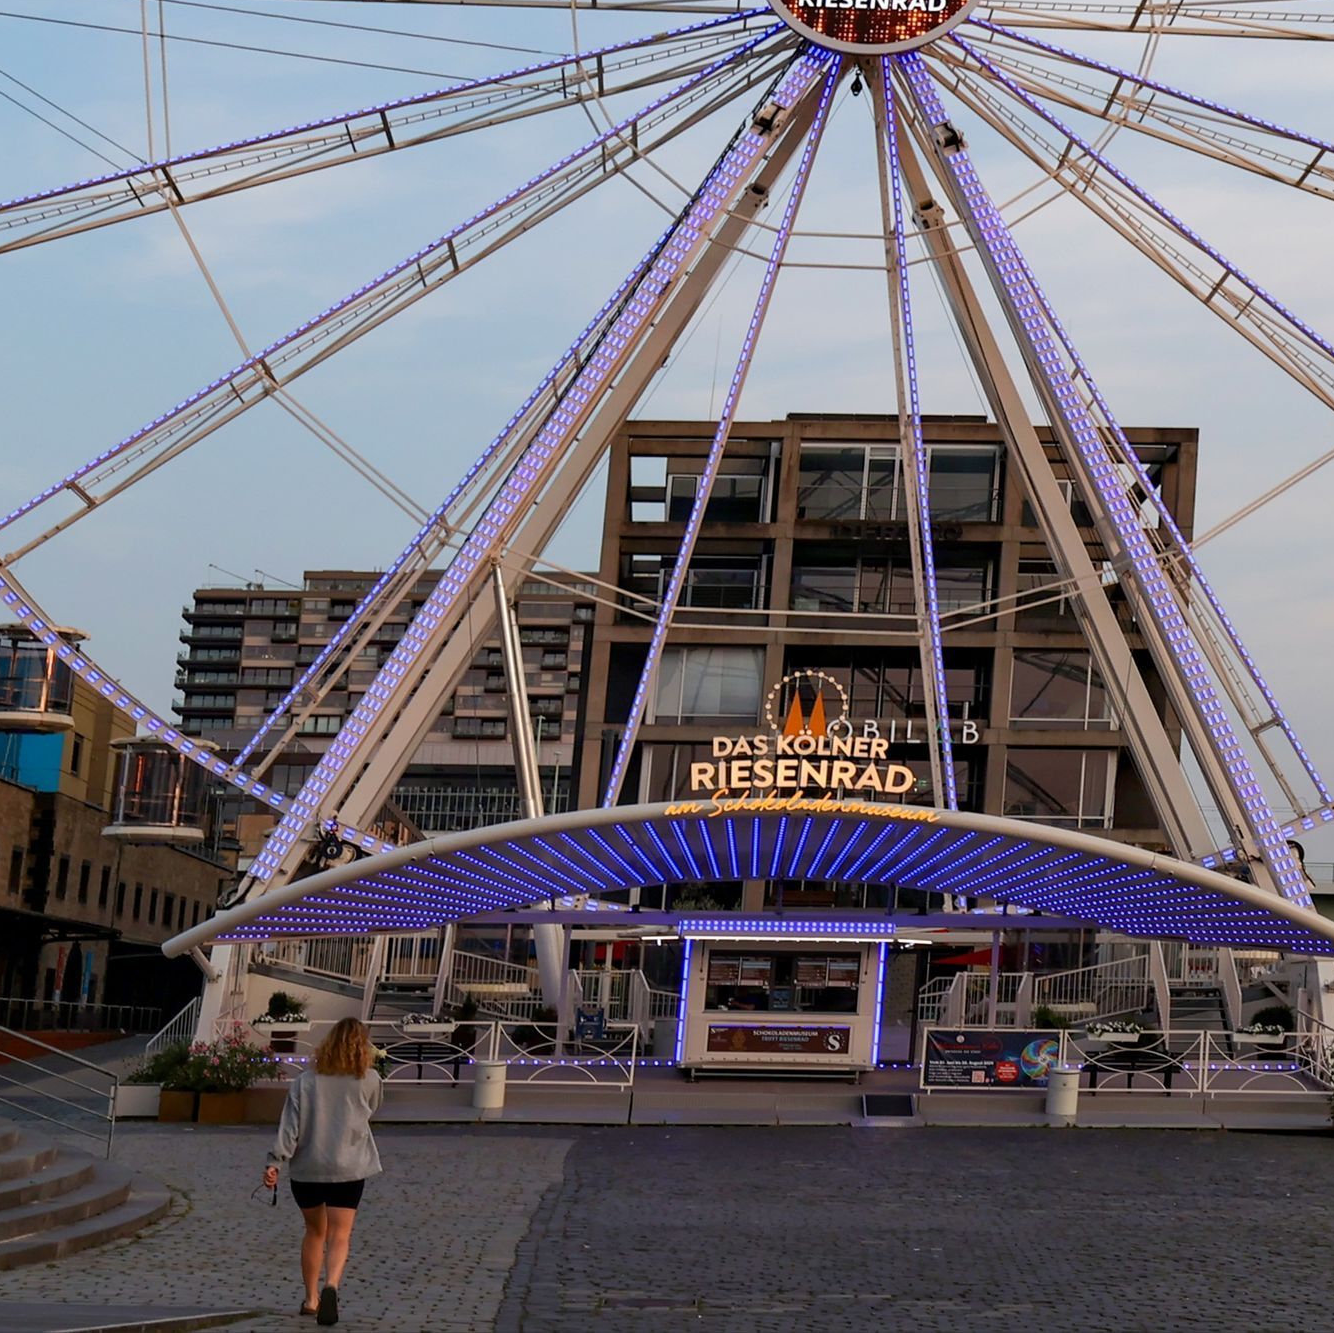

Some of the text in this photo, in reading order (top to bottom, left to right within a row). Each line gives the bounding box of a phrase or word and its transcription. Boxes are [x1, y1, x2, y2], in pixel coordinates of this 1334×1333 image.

[712, 729, 888, 759] DAS KÖLNER
[691, 759, 914, 793] RIESENRAD
[664, 789, 940, 823] am Schokoladenmuseum
[753, 1029, 818, 1037] SCHOKOLADENMUSEUM
[827, 1034, 840, 1051] S
